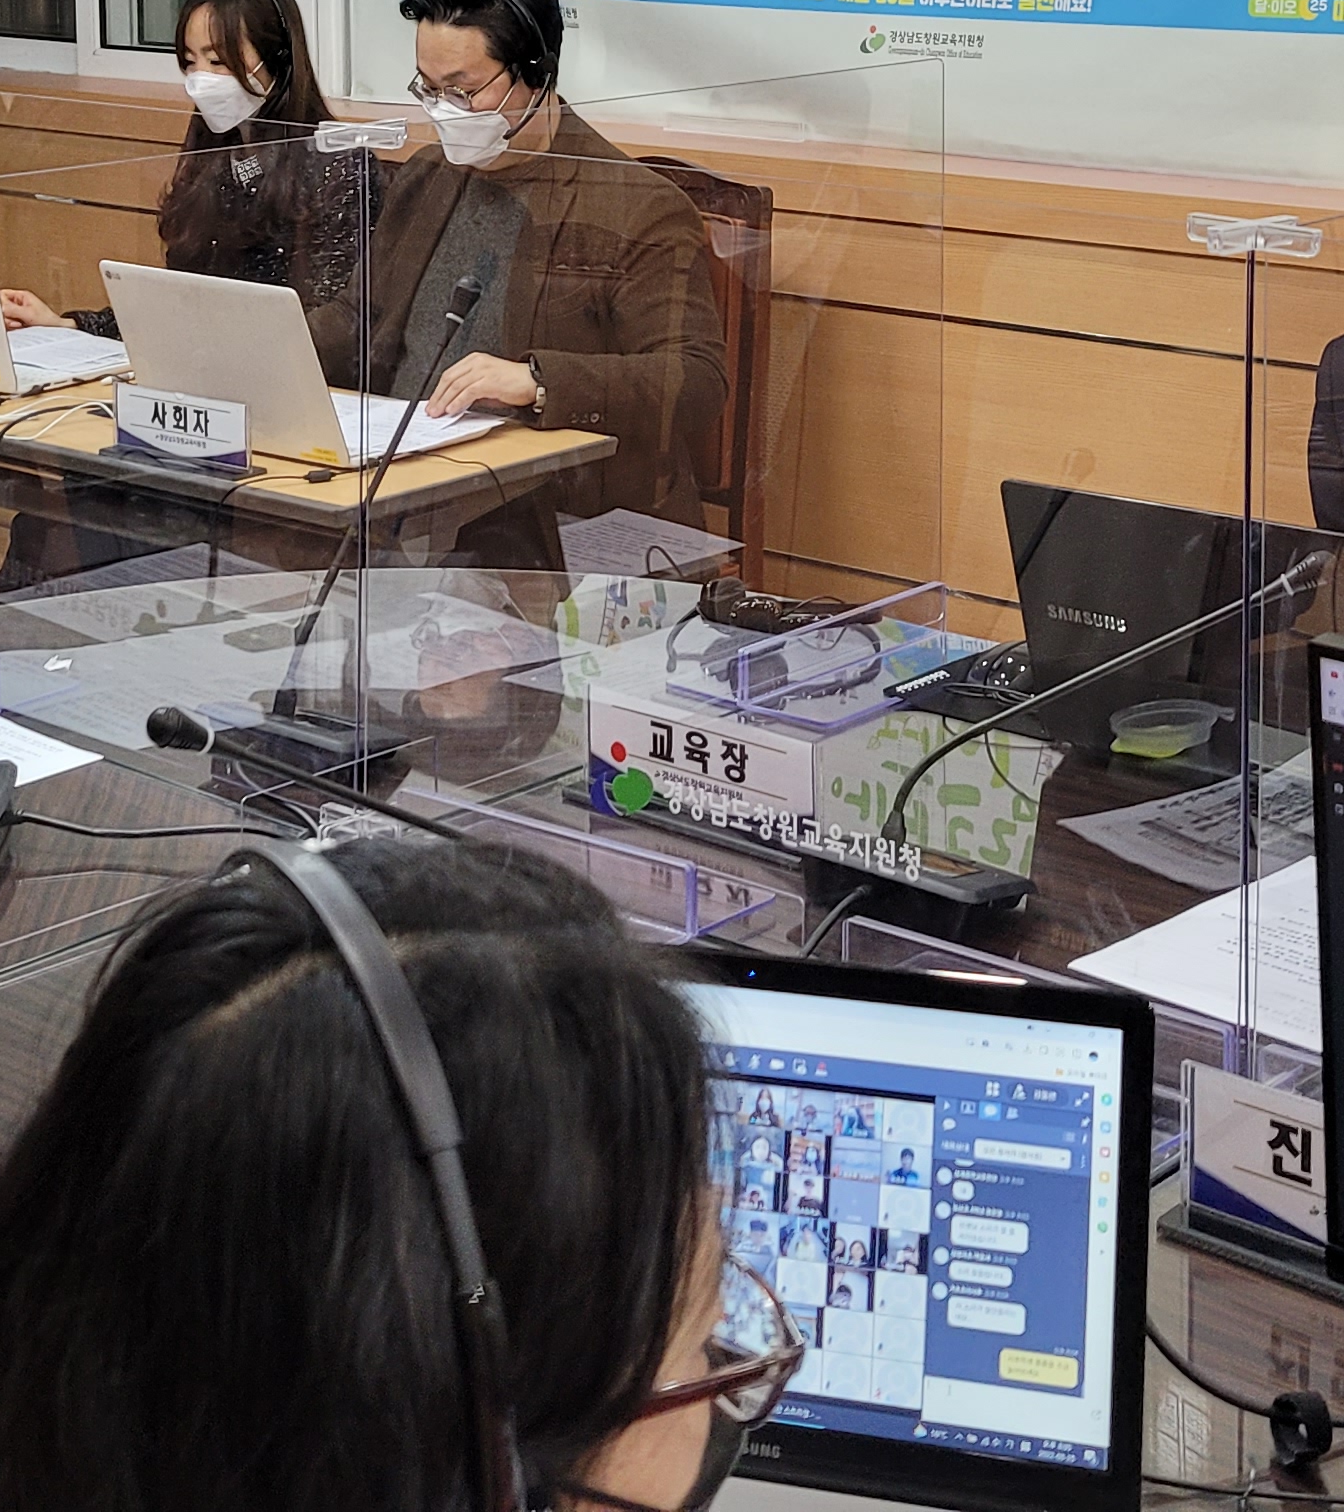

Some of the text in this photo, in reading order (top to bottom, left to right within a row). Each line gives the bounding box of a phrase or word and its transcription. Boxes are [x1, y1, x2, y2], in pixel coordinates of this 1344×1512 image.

[1309, 0, 1327, 12] 25
[889, 30, 985, 48] 경상남도창원교육지원청
[151, 401, 209, 437] 사회자
[1047, 603, 1127, 632] SAMSUNG
[649, 720, 749, 783] 교육장
[664, 780, 921, 882] 경상남도창원교육지원청
